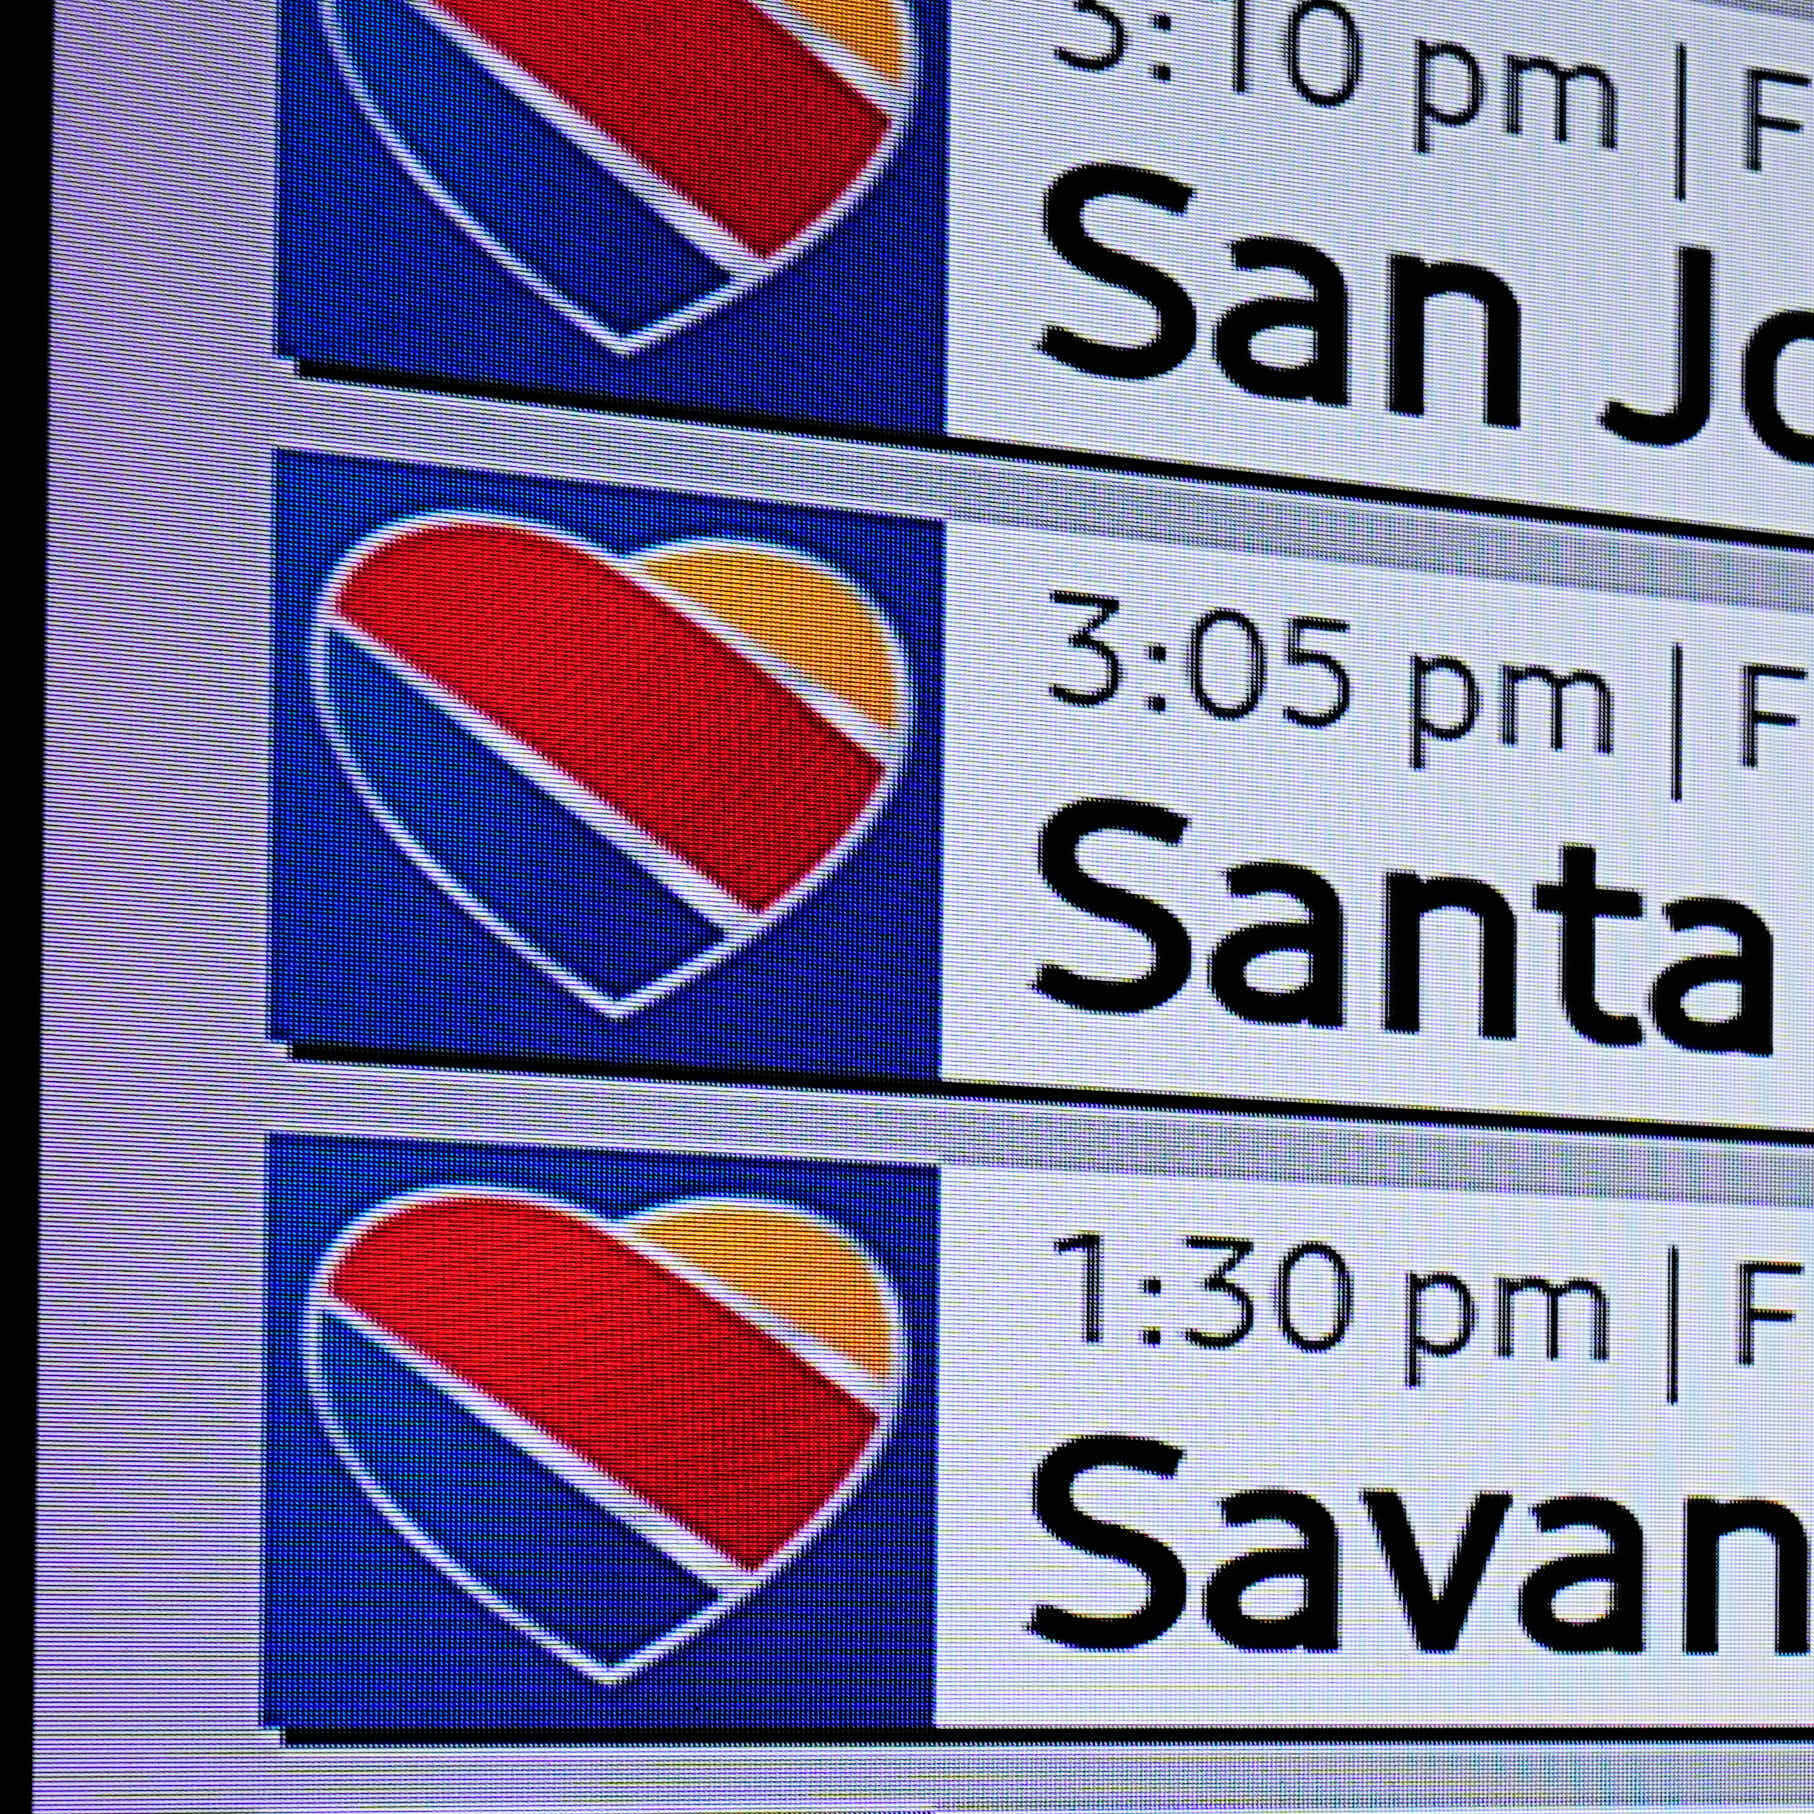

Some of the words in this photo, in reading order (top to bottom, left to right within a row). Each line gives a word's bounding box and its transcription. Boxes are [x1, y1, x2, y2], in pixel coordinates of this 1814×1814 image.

[1054, 0, 1363, 108] 3:10
[1414, 39, 1617, 154] pm
[1037, 163, 1521, 429] San
[1049, 590, 1351, 729] 3:05
[1410, 655, 1613, 770] pm
[1032, 797, 1774, 1057] Santa
[1054, 1232, 1353, 1353] 1:30
[1405, 1272, 1609, 1388] pm
